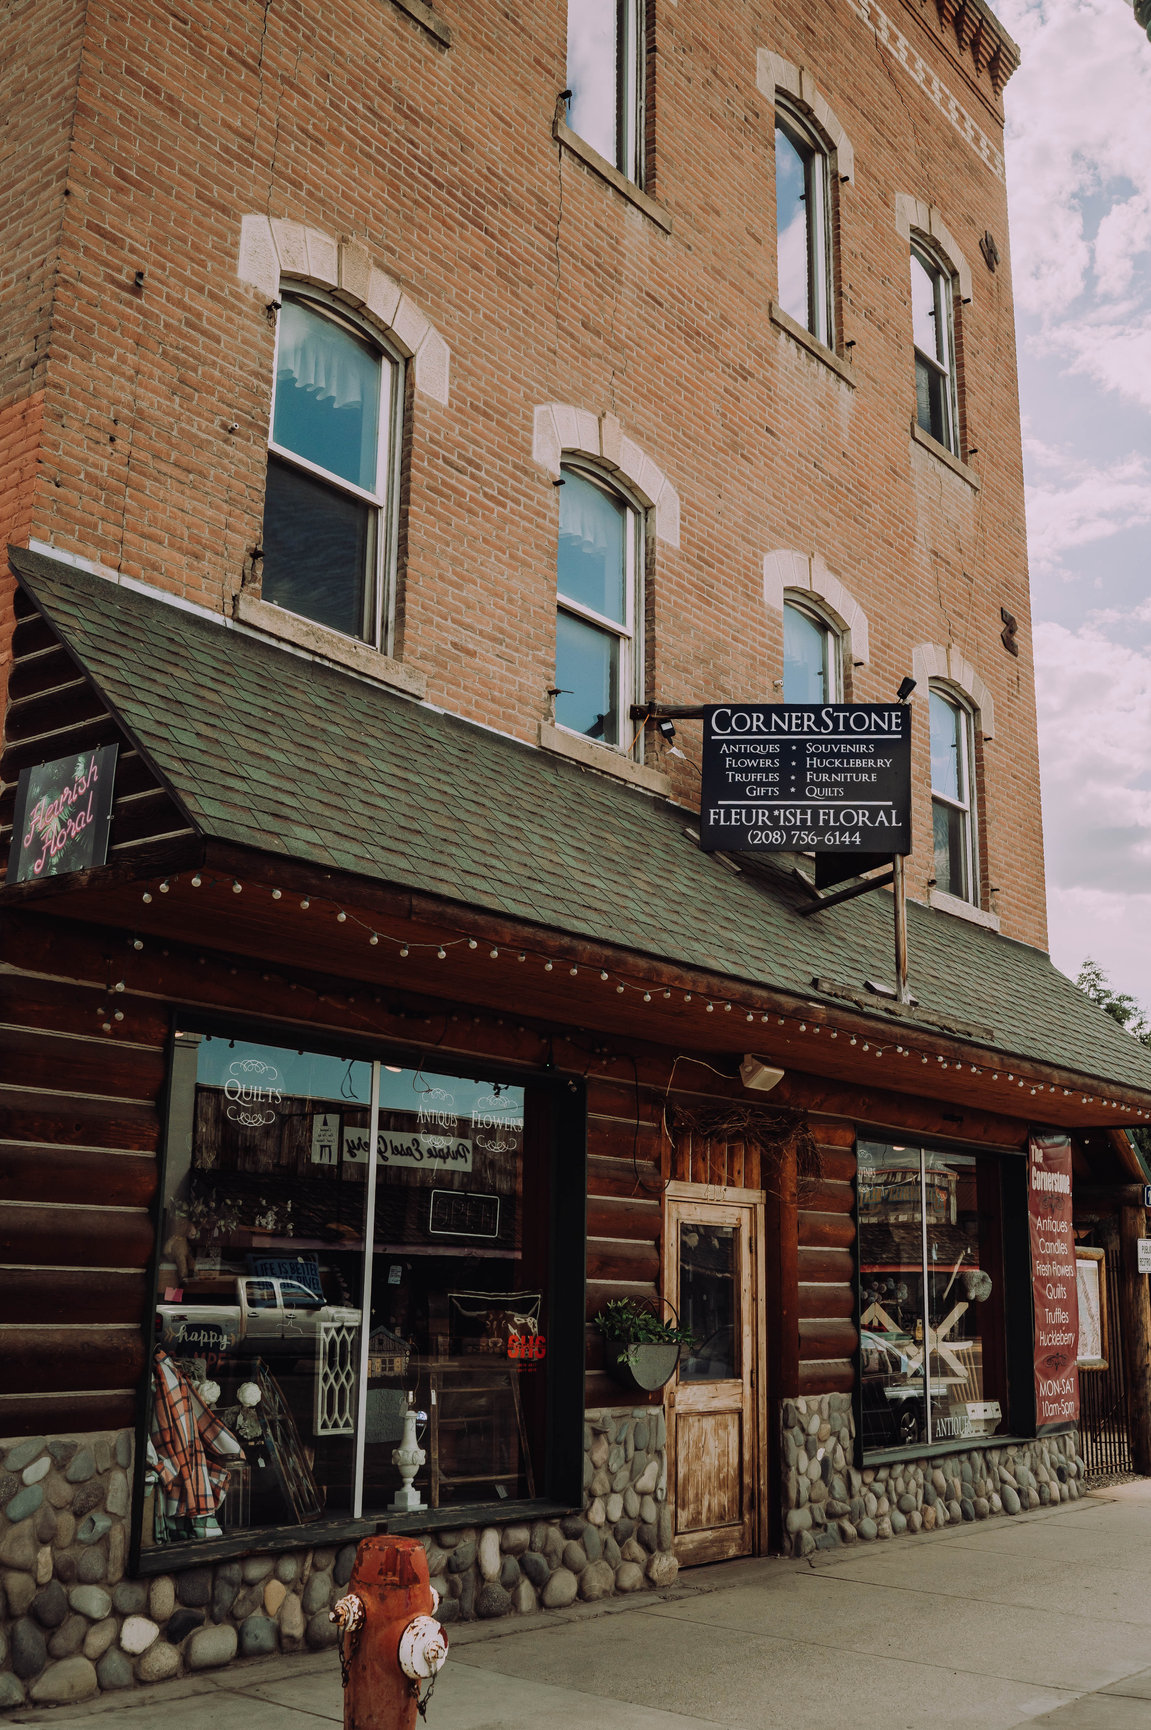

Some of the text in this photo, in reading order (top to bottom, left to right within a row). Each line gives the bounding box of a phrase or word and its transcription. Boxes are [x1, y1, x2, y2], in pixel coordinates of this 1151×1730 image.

[720, 743, 875, 755] ANTIQUES SOUVENIRS
[725, 757, 893, 768] FLOWERS HUCKLEBERRY
[726, 772, 877, 782] TRUFFLES FURNITURE
[746, 786, 844, 799] GIFTS QUILTS
[818, 809, 902, 827] FLORAL
[747, 829, 861, 846] (208) 756-6144
[224, 1079, 282, 1106] QUILTS
[416, 1105, 458, 1129] ANTIQUES
[471, 1110, 523, 1132] FLOWERS
[1031, 1145, 1043, 1163] The
[1031, 1166, 1070, 1194] Cornerstone
[1036, 1216, 1068, 1235] Antiques
[1039, 1238, 1068, 1255] Candles
[1036, 1260, 1074, 1278] Fresh Flowers
[1045, 1283, 1067, 1299] Quilts
[1045, 1308, 1069, 1324] Truffles
[175, 1324, 231, 1351] happy
[1039, 1330, 1075, 1348] Huckleberry
[1040, 1378, 1074, 1397] MON-SAT
[1042, 1399, 1074, 1417] 10am-5pm
